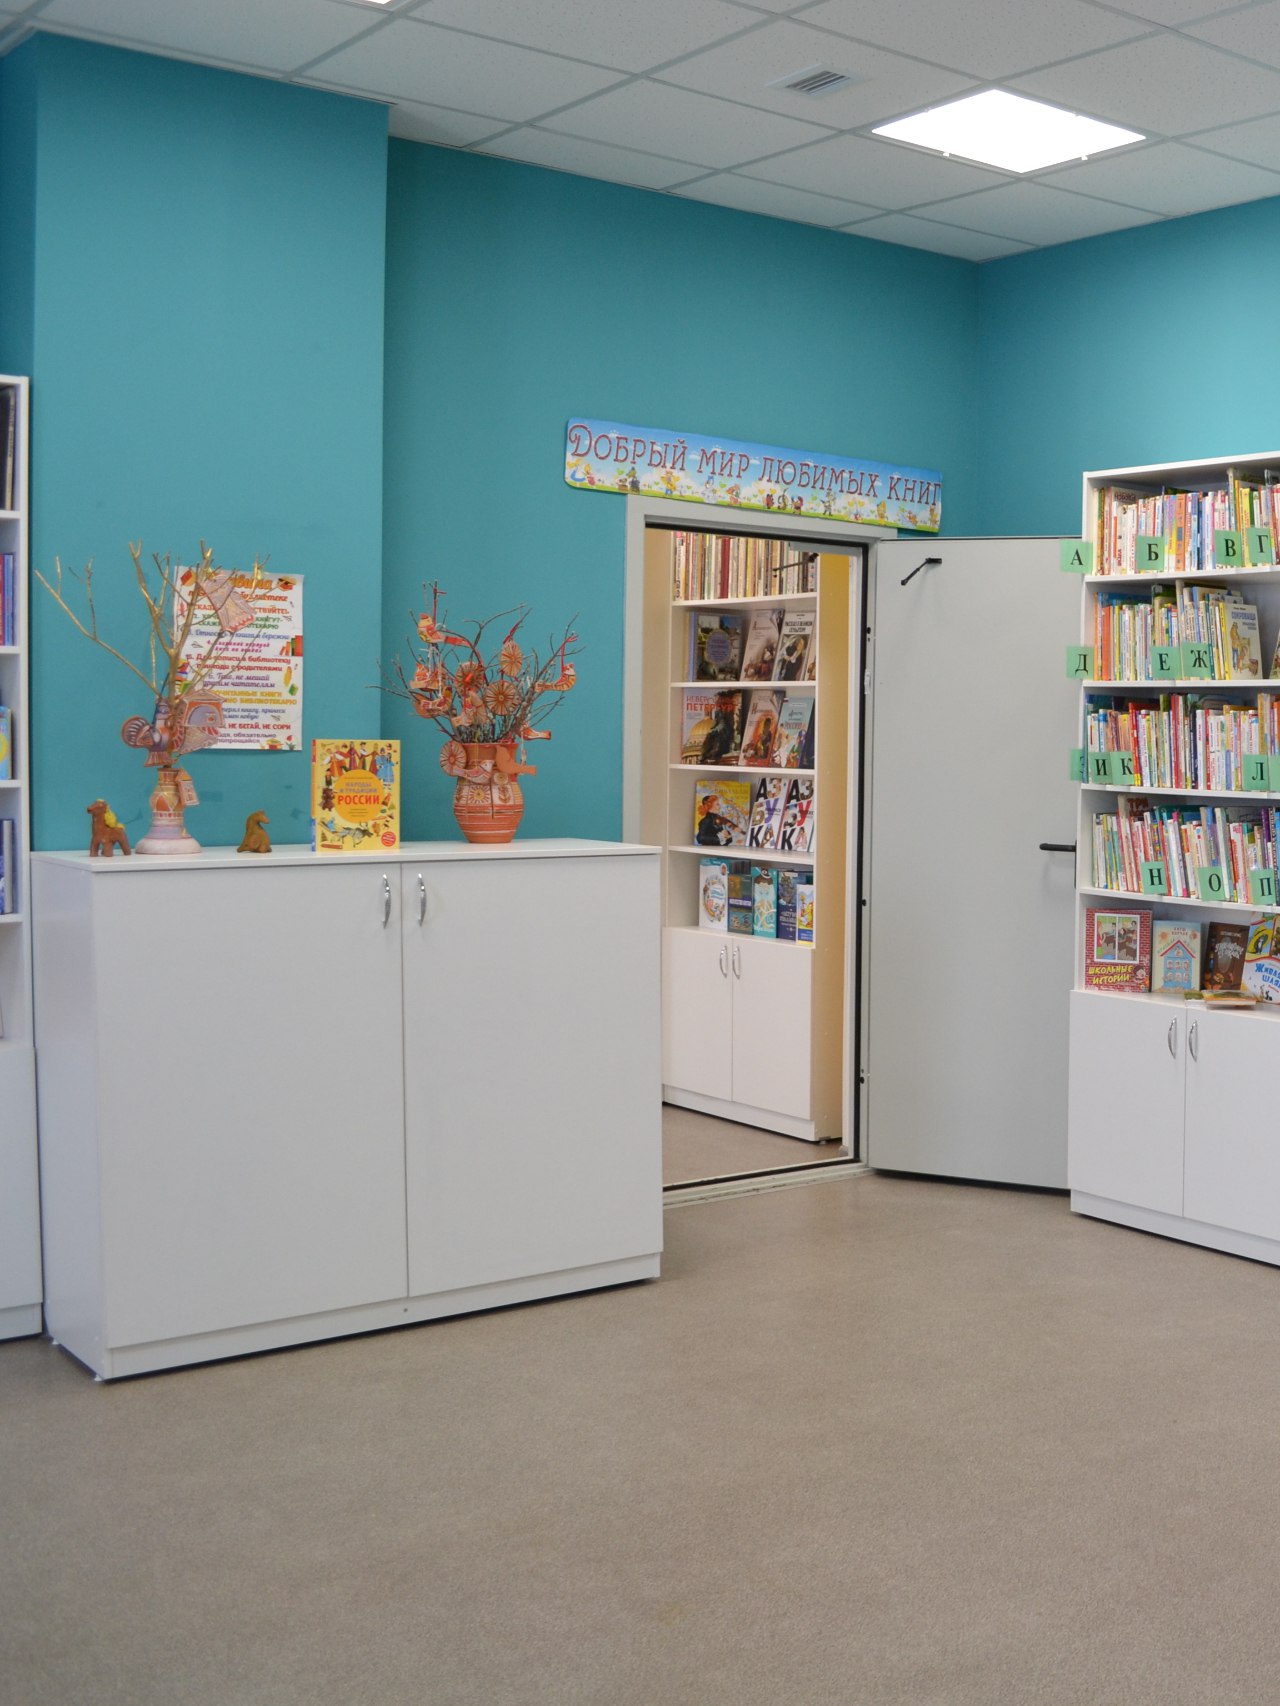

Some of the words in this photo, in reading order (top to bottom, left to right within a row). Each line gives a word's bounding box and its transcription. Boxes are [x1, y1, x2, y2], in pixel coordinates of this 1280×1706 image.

[568, 424, 688, 471] ДОБРЫЙ
[697, 448, 751, 479] МИР
[758, 456, 880, 497] ЛЮБИМЫХ
[887, 476, 942, 506] КНИГ
[1147, 543, 1159, 561] Б
[1224, 538, 1237, 557] В
[1257, 534, 1269, 553] Г
[1070, 549, 1084, 566] А
[1075, 657, 1089, 675] Д
[1159, 654, 1171, 671] Е
[1190, 649, 1209, 668] Ж
[1095, 758, 1109, 777] И
[1120, 758, 1133, 776] К
[1251, 762, 1265, 782] Л
[337, 794, 380, 805] РОССИИ
[1149, 867, 1164, 887] Н
[1208, 873, 1222, 892] О
[1259, 877, 1273, 897] П
[1088, 965, 1134, 975] ШКОЛЬНЫЕ
[1092, 974, 1130, 985] ИСТОРИИ
